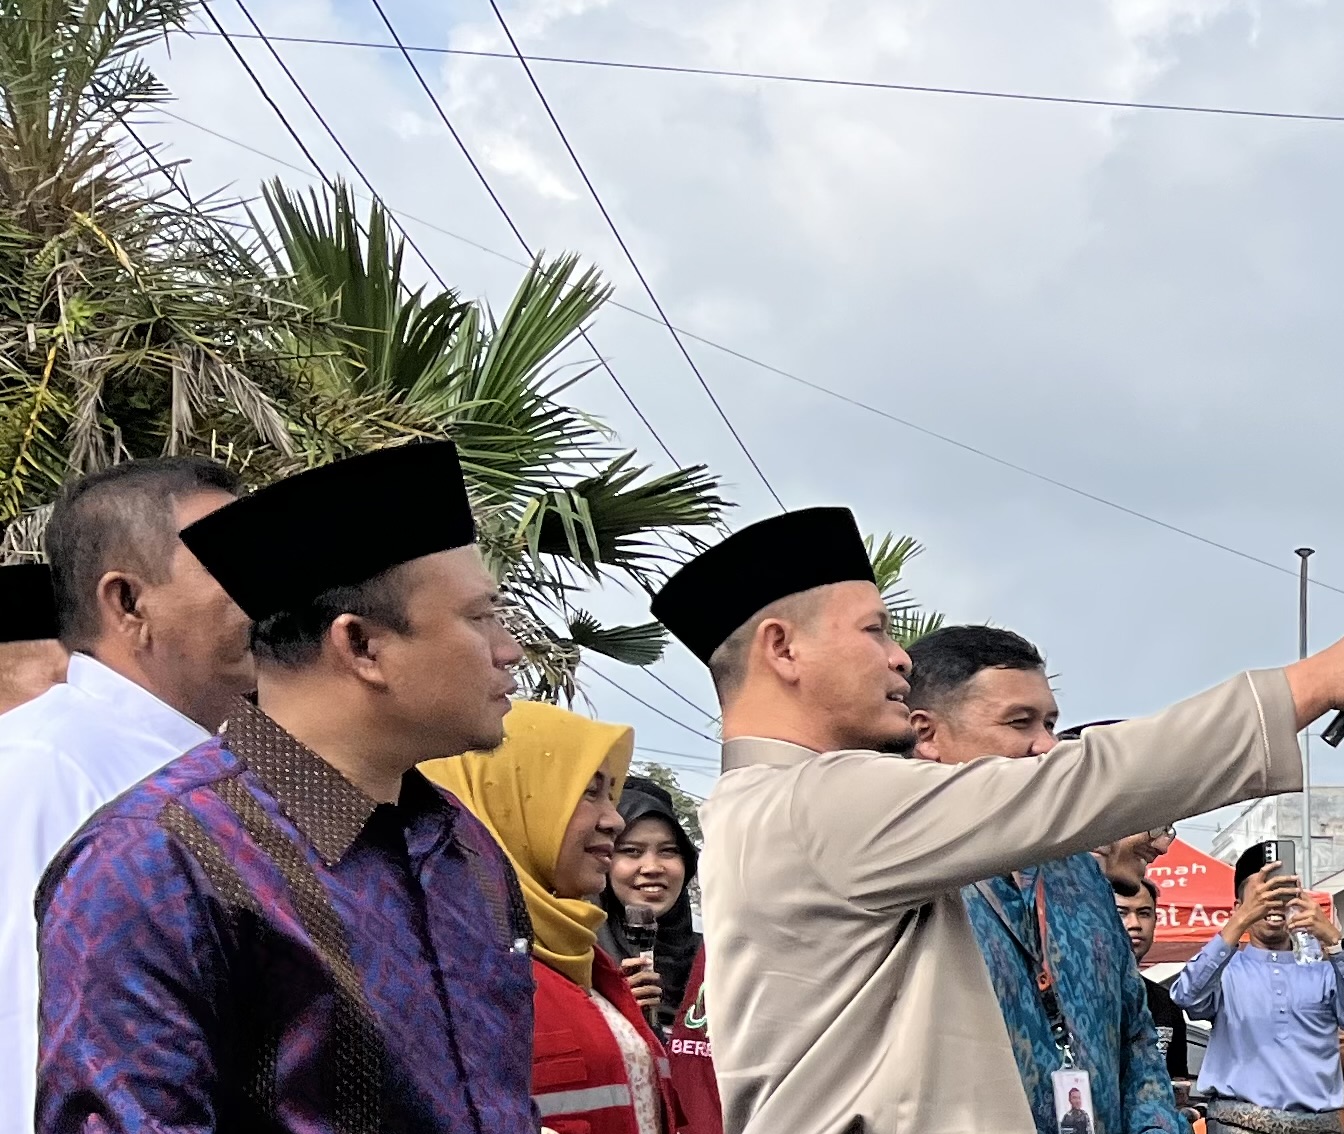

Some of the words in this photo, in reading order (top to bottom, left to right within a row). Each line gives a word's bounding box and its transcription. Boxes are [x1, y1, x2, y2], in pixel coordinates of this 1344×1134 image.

[1147, 862, 1207, 877] mah
[1160, 876, 1188, 888] at
[1156, 903, 1181, 926] at
[1187, 903, 1235, 927] Ac
